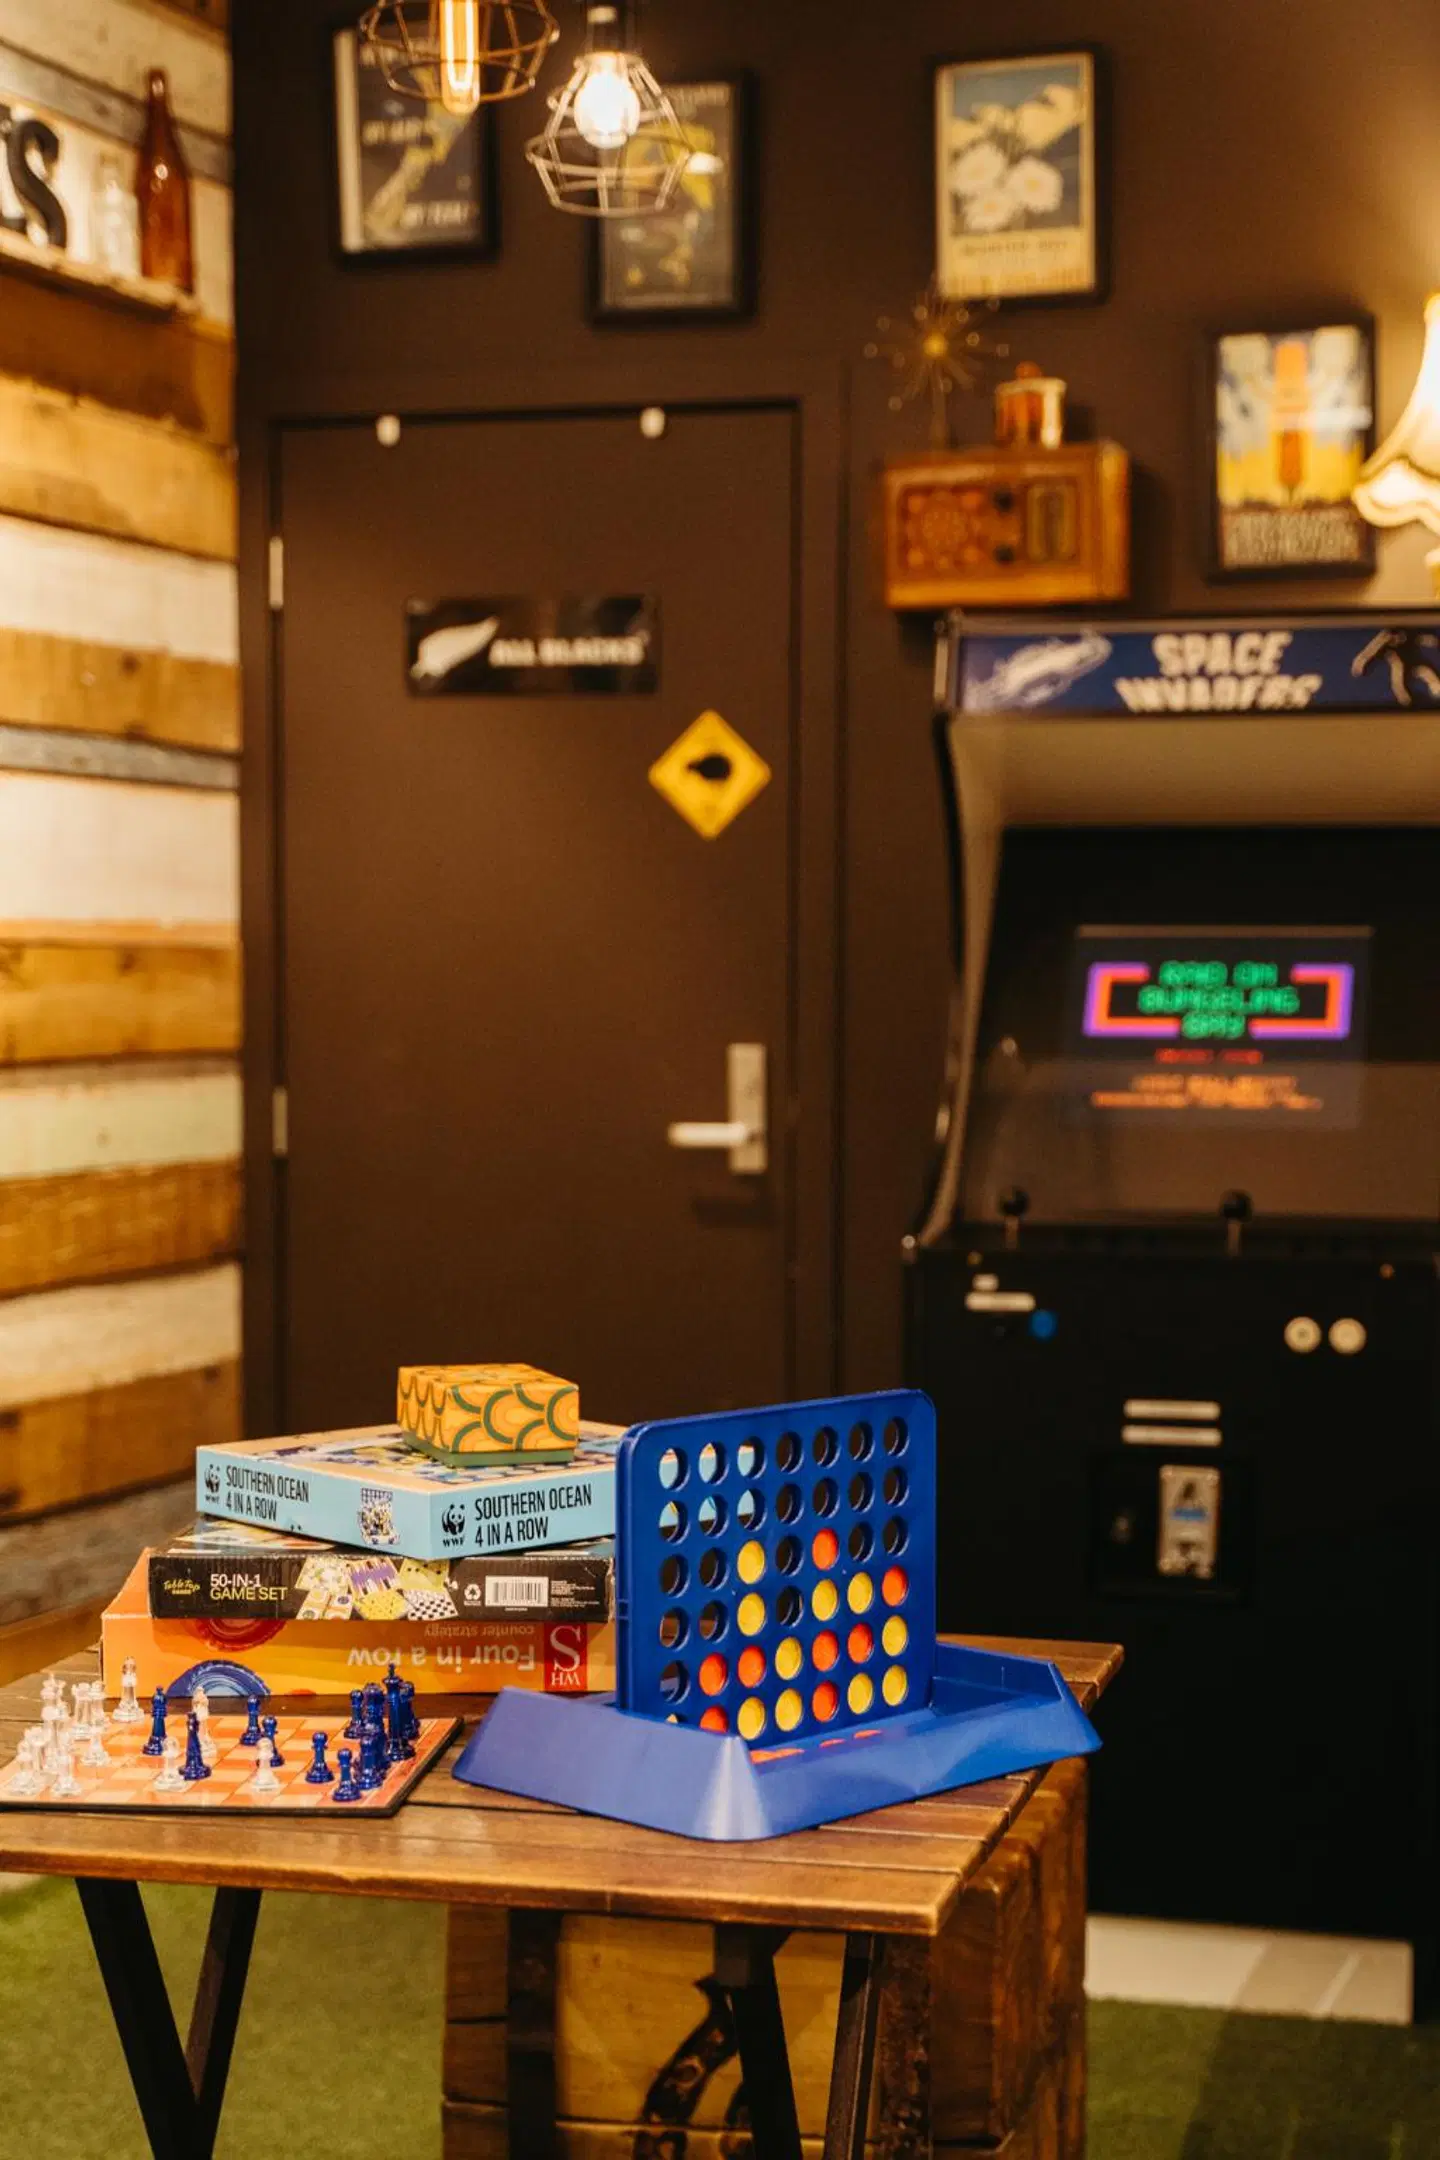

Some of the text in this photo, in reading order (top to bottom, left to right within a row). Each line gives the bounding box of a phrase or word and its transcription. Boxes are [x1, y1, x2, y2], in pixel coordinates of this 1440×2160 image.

[1153, 631, 1293, 676] SPACE
[1114, 674, 1322, 712] INVADERS
[225, 1465, 310, 1503] SOUTHERN OCEAN
[225, 1491, 277, 1521] 4 IN A ROW
[475, 1484, 592, 1521] SOUTHERN OCEAN
[442, 1536, 465, 1548] WWF
[475, 1516, 549, 1548] 4 IN A ROW
[210, 1574, 261, 1587] 50-IN-1
[210, 1587, 288, 1600] GAME SET
[424, 1624, 535, 1638] counter strategy
[347, 1644, 536, 1673] Four in a row
[549, 1625, 581, 1672] S
[551, 1671, 581, 1687] WH
